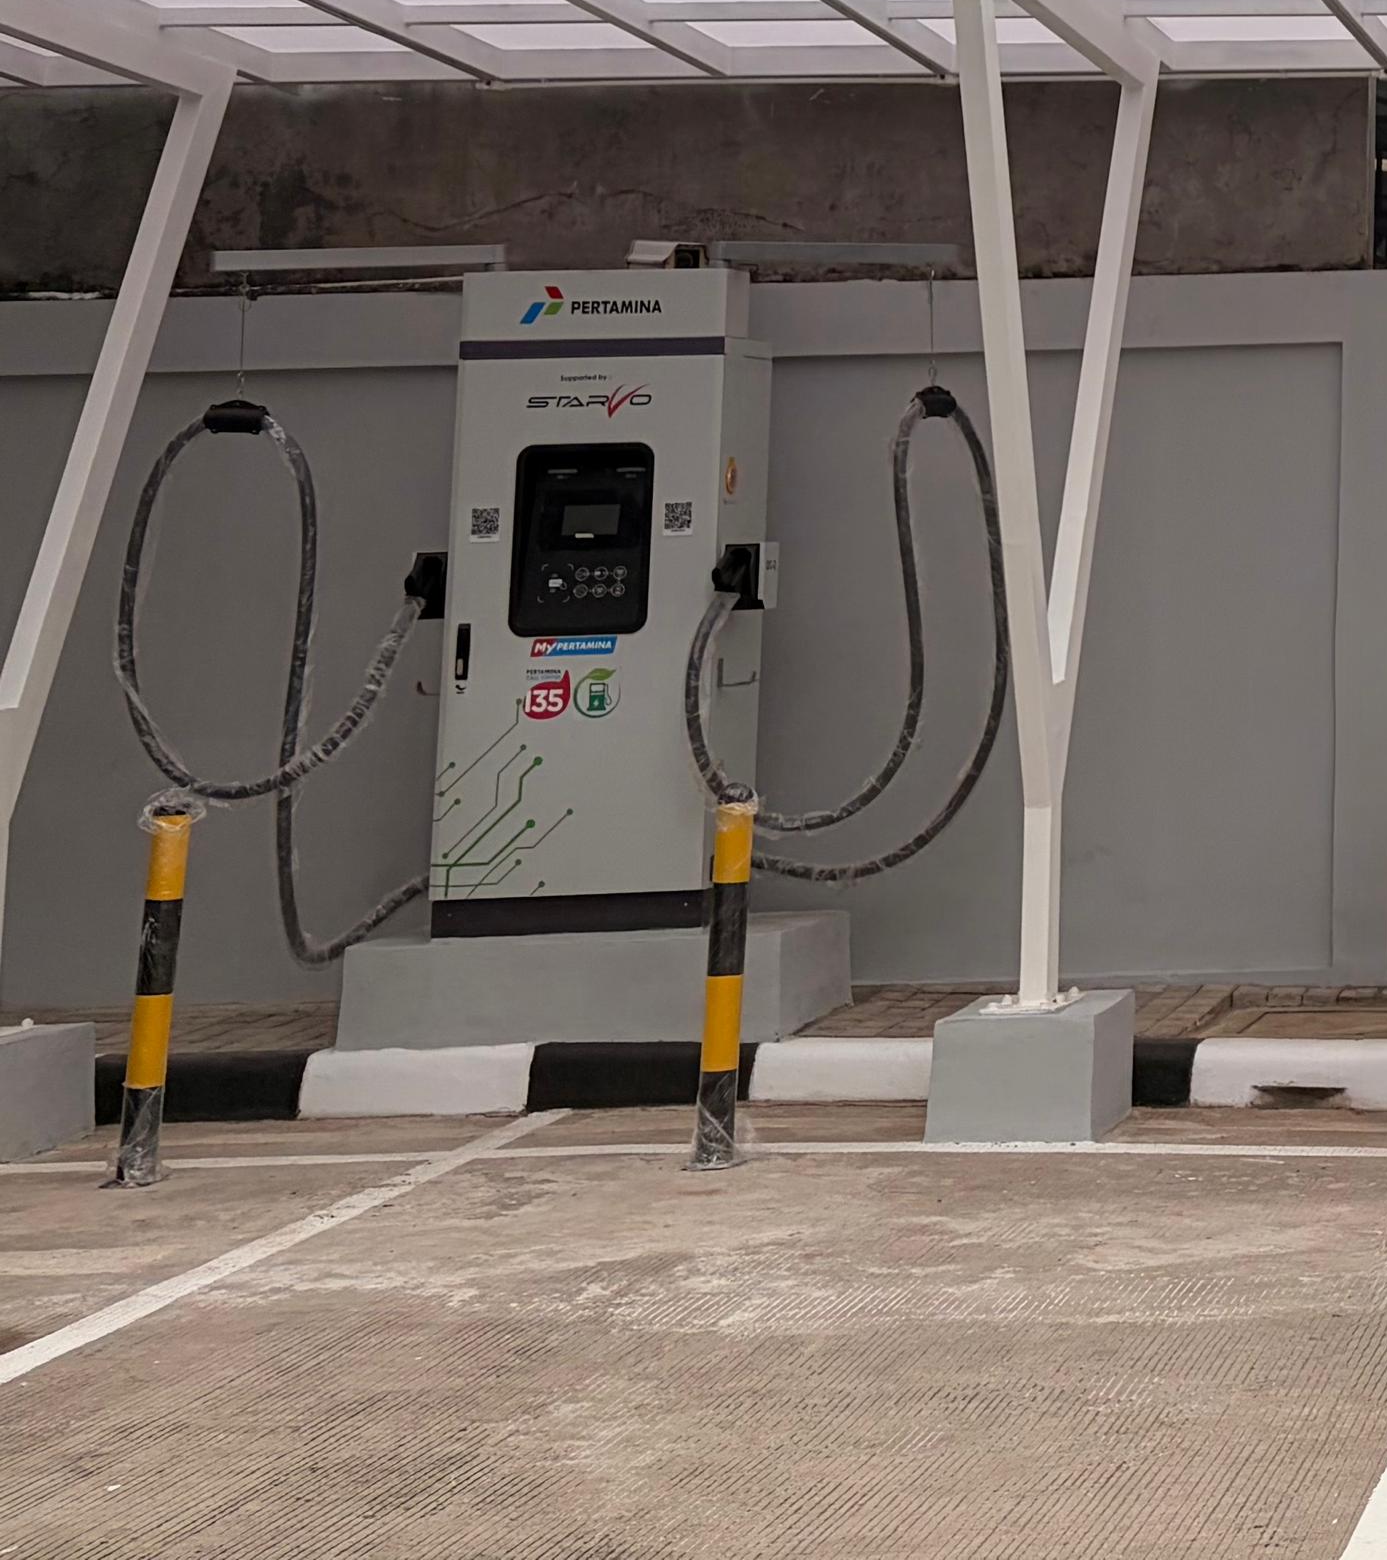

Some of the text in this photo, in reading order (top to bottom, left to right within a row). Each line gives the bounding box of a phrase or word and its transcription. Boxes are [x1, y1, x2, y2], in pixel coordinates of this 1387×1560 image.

[570, 299, 662, 315] PERTAMINA
[526, 383, 652, 418] STARVO
[524, 688, 564, 713] 135
